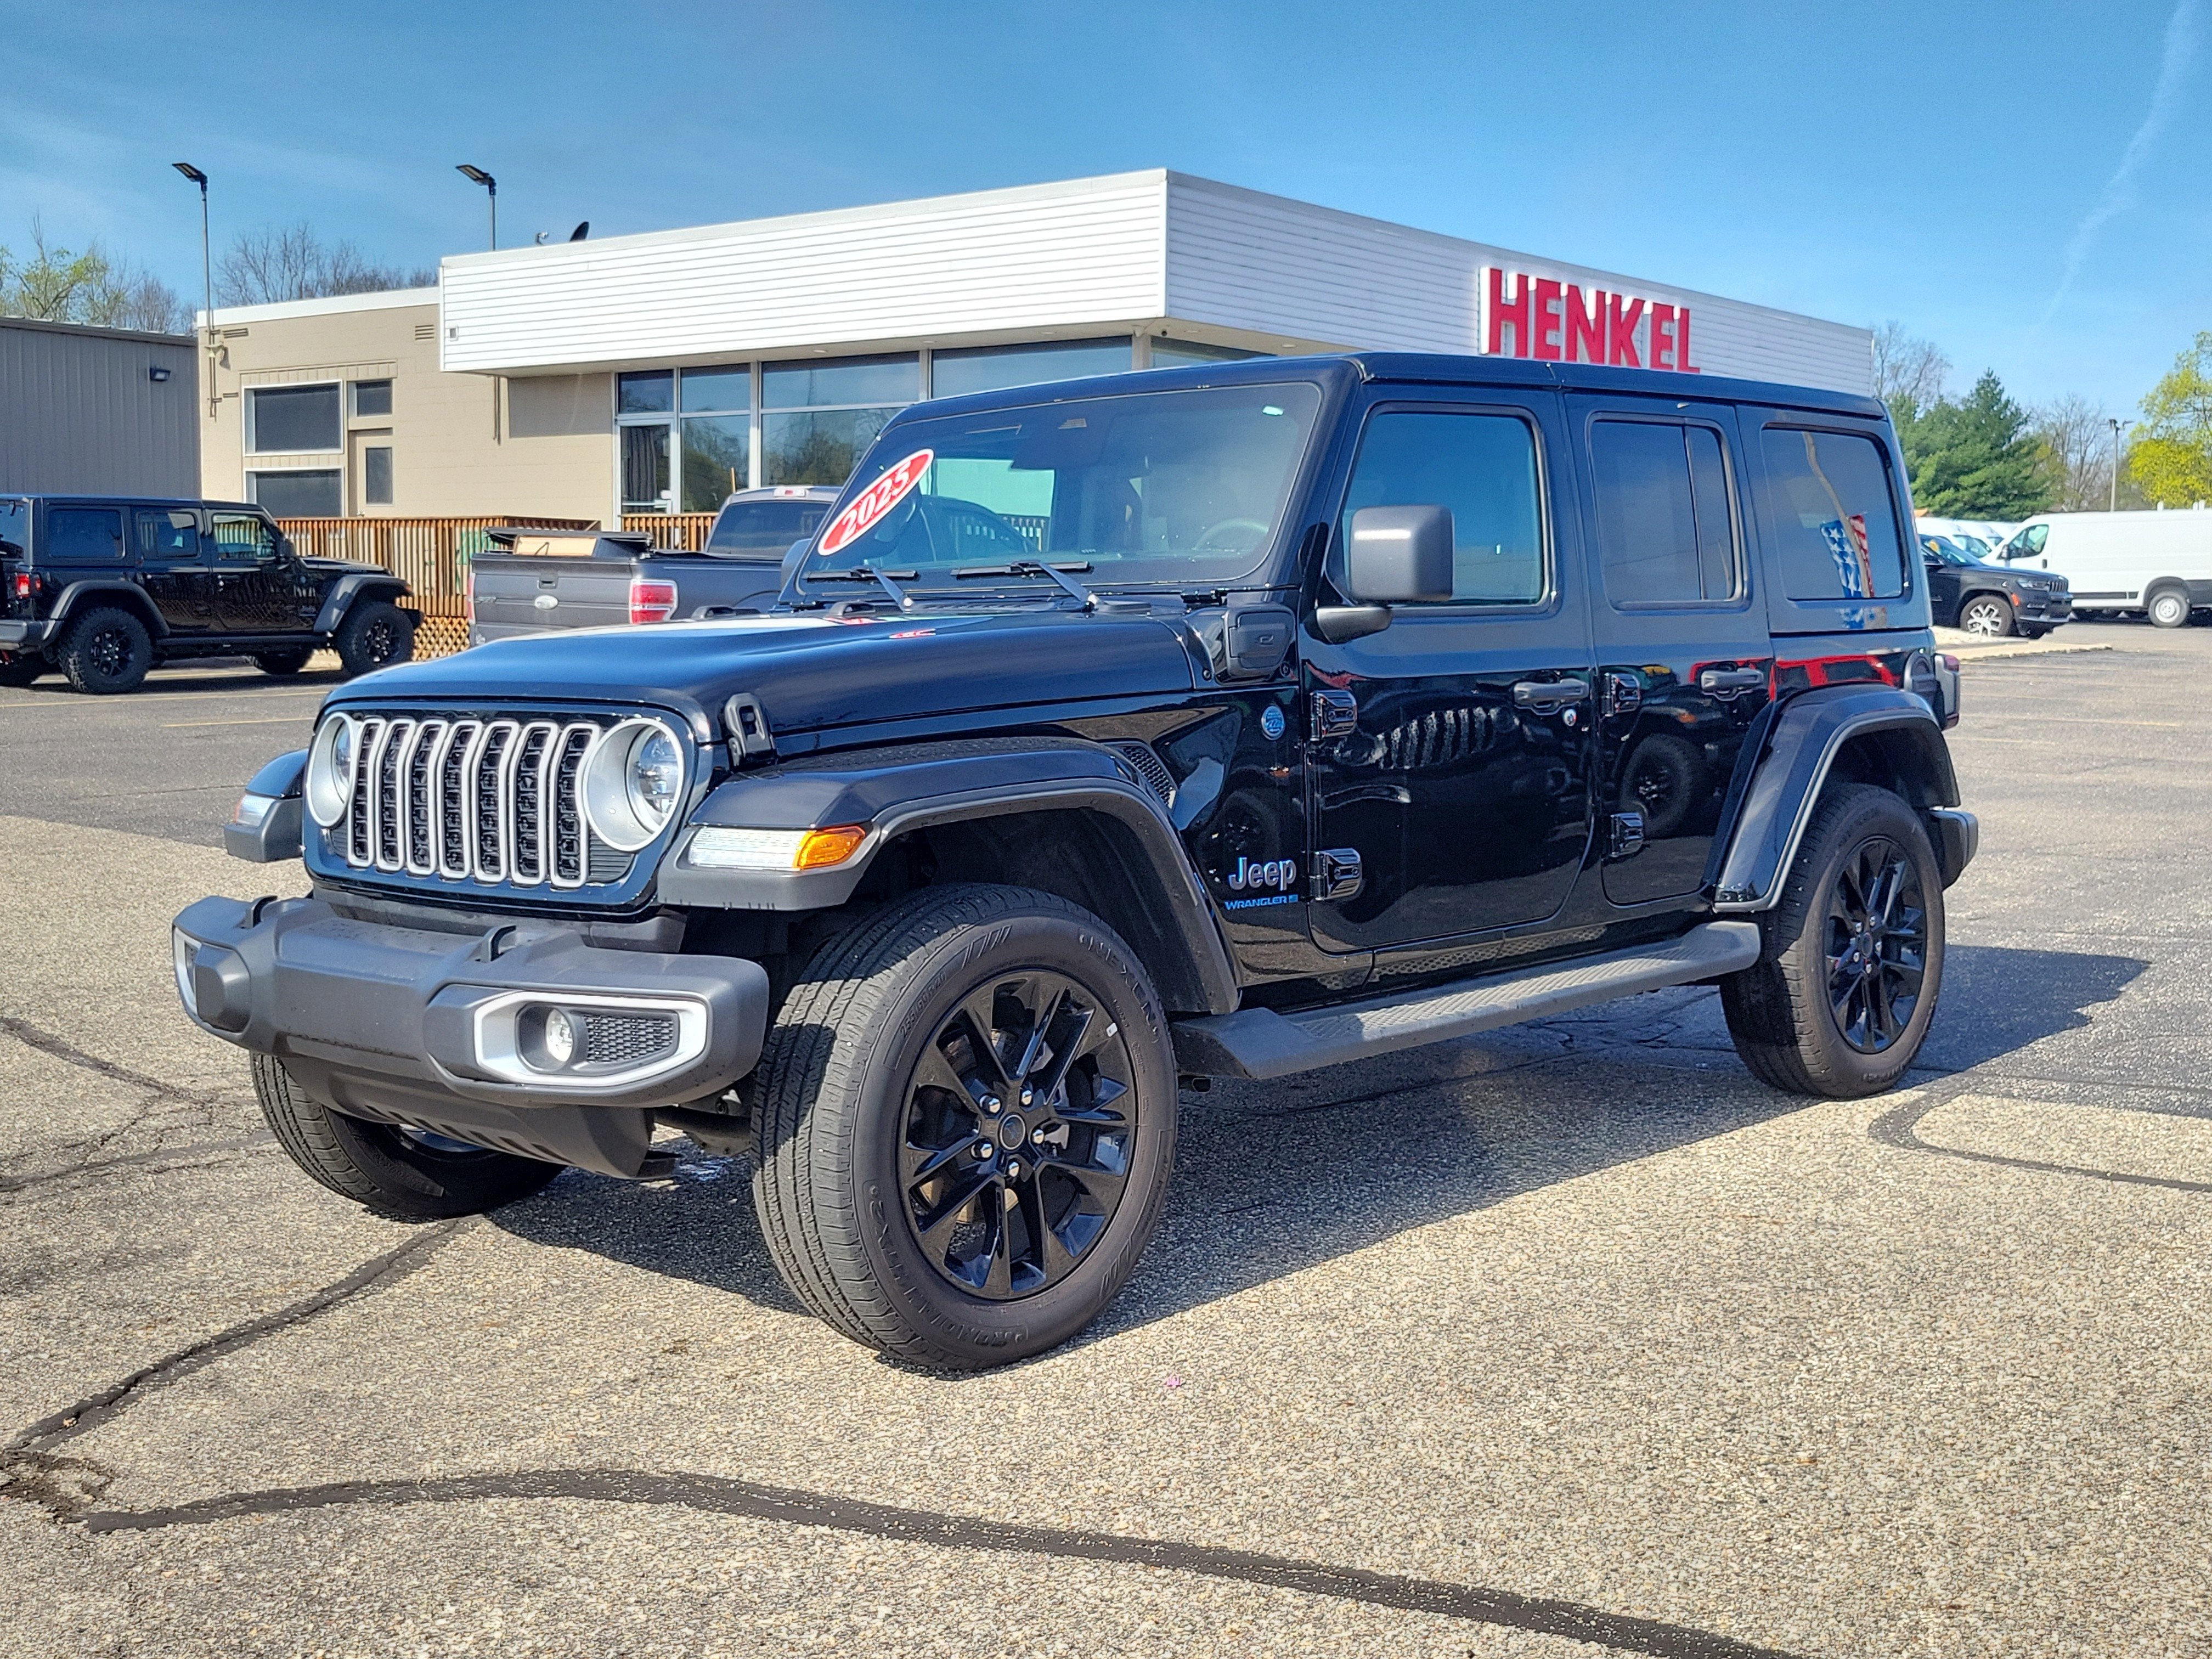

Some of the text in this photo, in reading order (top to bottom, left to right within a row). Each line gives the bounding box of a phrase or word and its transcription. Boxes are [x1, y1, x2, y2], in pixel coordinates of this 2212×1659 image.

[1487, 268, 1700, 374] HENKEL
[838, 460, 911, 544] 2025
[1224, 895, 1287, 910] WRANGLER
[1228, 857, 1297, 891] Jeep
